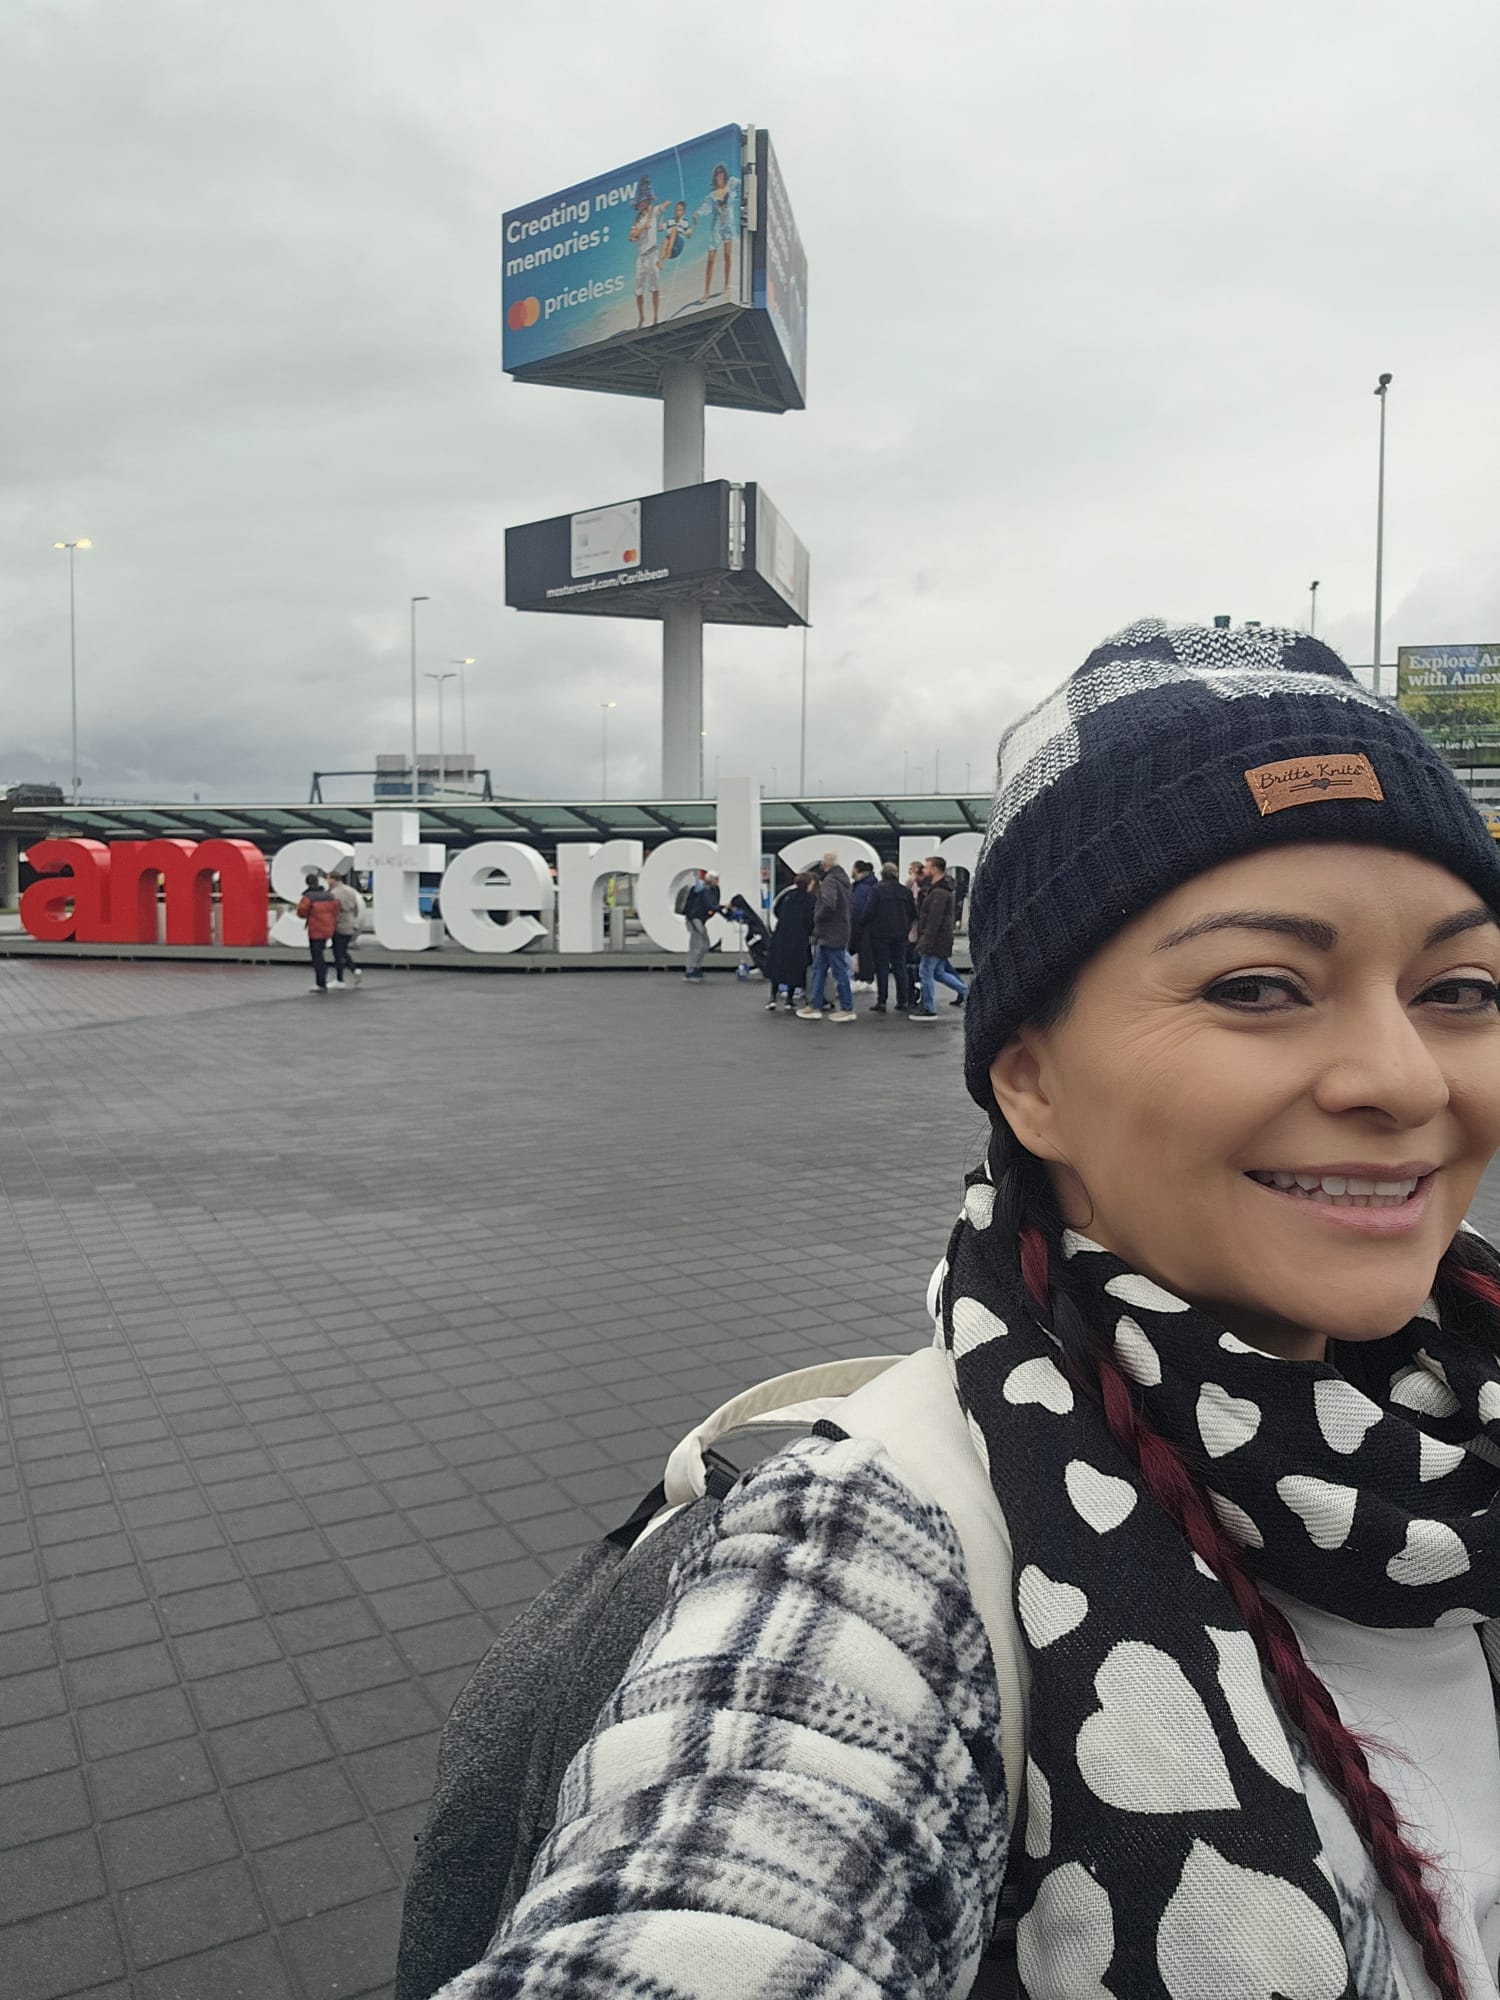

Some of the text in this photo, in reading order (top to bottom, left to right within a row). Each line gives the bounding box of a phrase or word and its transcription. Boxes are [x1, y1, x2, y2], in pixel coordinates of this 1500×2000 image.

[506, 181, 639, 244] Creating new
[506, 226, 609, 277] memories:
[544, 275, 625, 320] priceless
[1408, 654, 1477, 673] Explore
[1408, 671, 1448, 686] with
[1261, 763, 1361, 789] Britt's Knits
